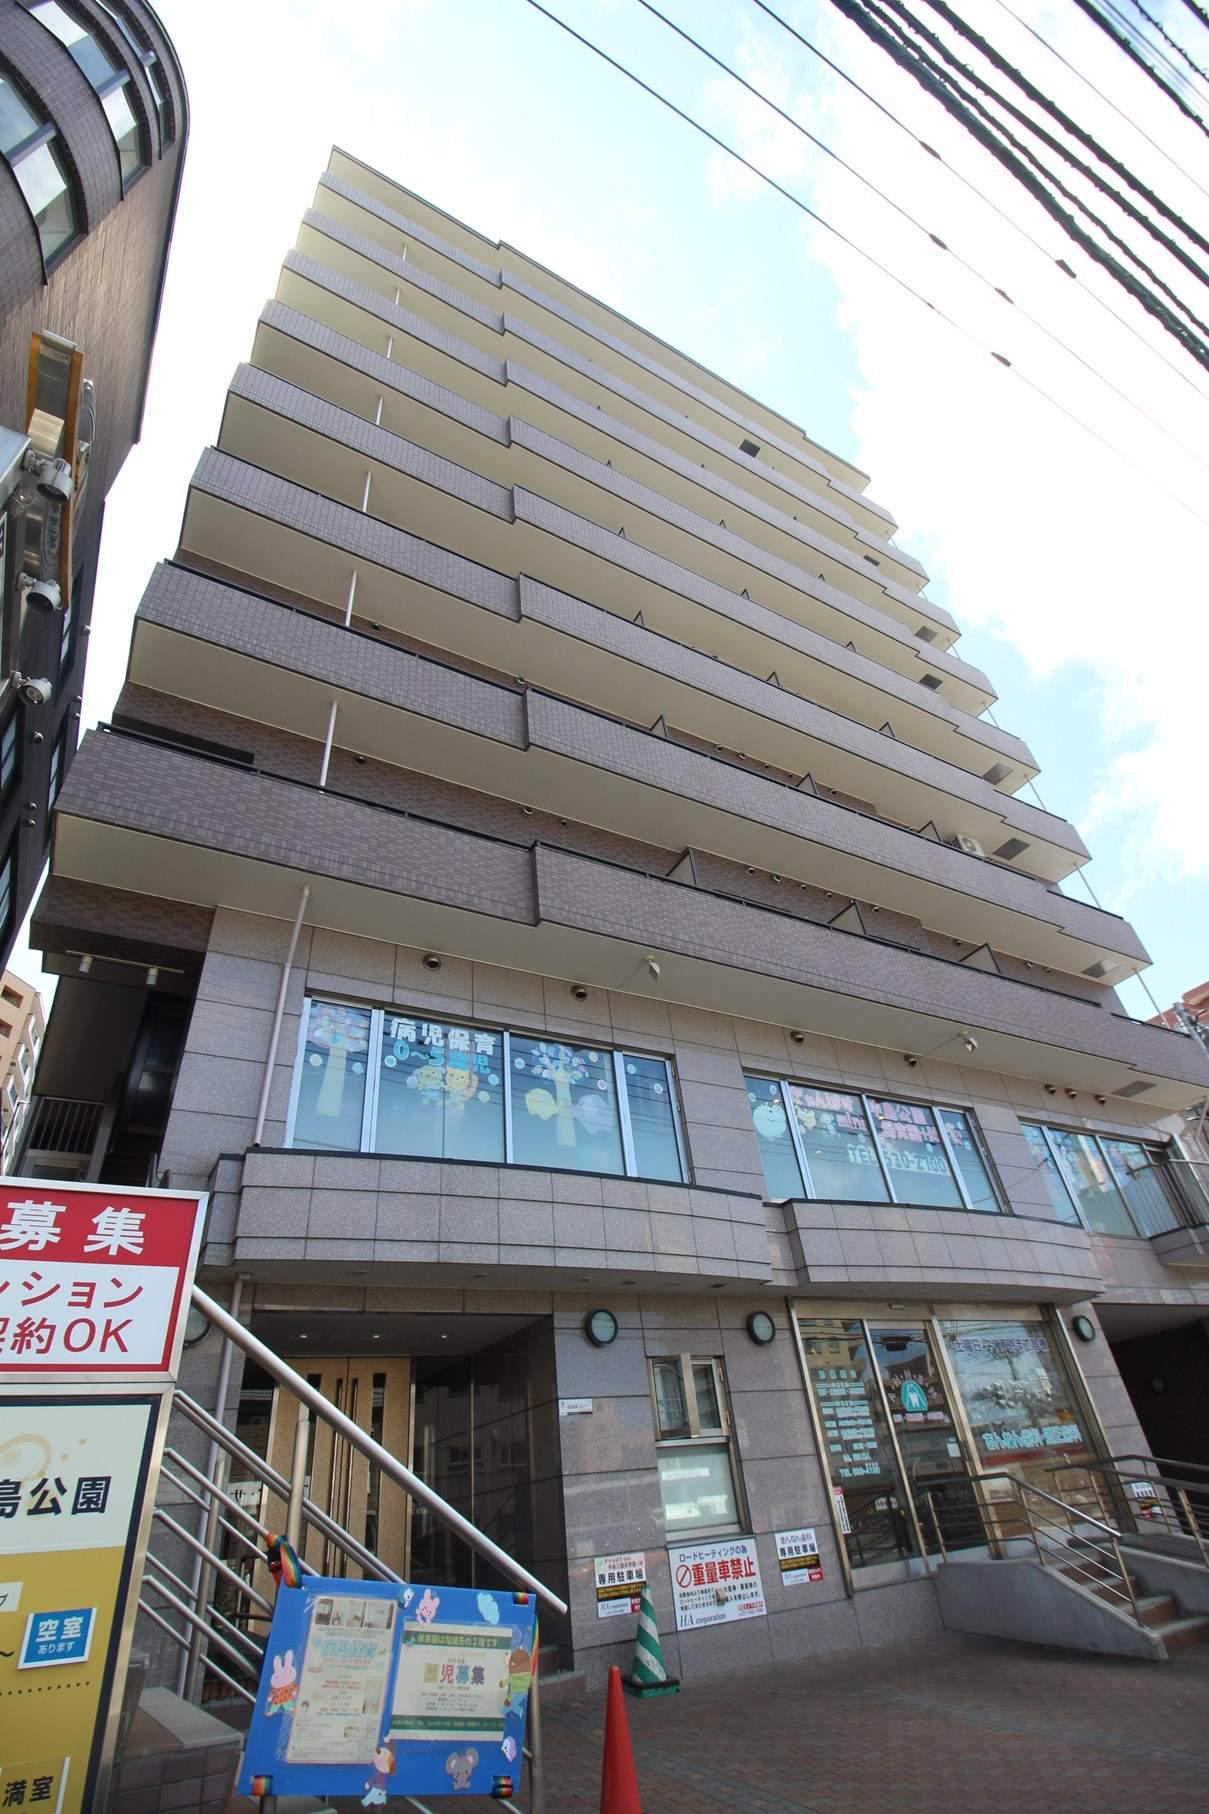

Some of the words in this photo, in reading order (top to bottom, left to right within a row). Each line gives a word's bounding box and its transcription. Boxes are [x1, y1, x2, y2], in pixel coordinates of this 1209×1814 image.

[388, 1018, 496, 1056] 病児保育
[0, 1200, 146, 1256] 募集
[0, 1271, 143, 1309] ション
[0, 1316, 133, 1354] 約OK
[692, 1556, 756, 1586] 重量車禁止
[36, 1615, 84, 1642] 空室
[37, 1640, 76, 1655] あります
[2, 1775, 54, 1807] 満室
